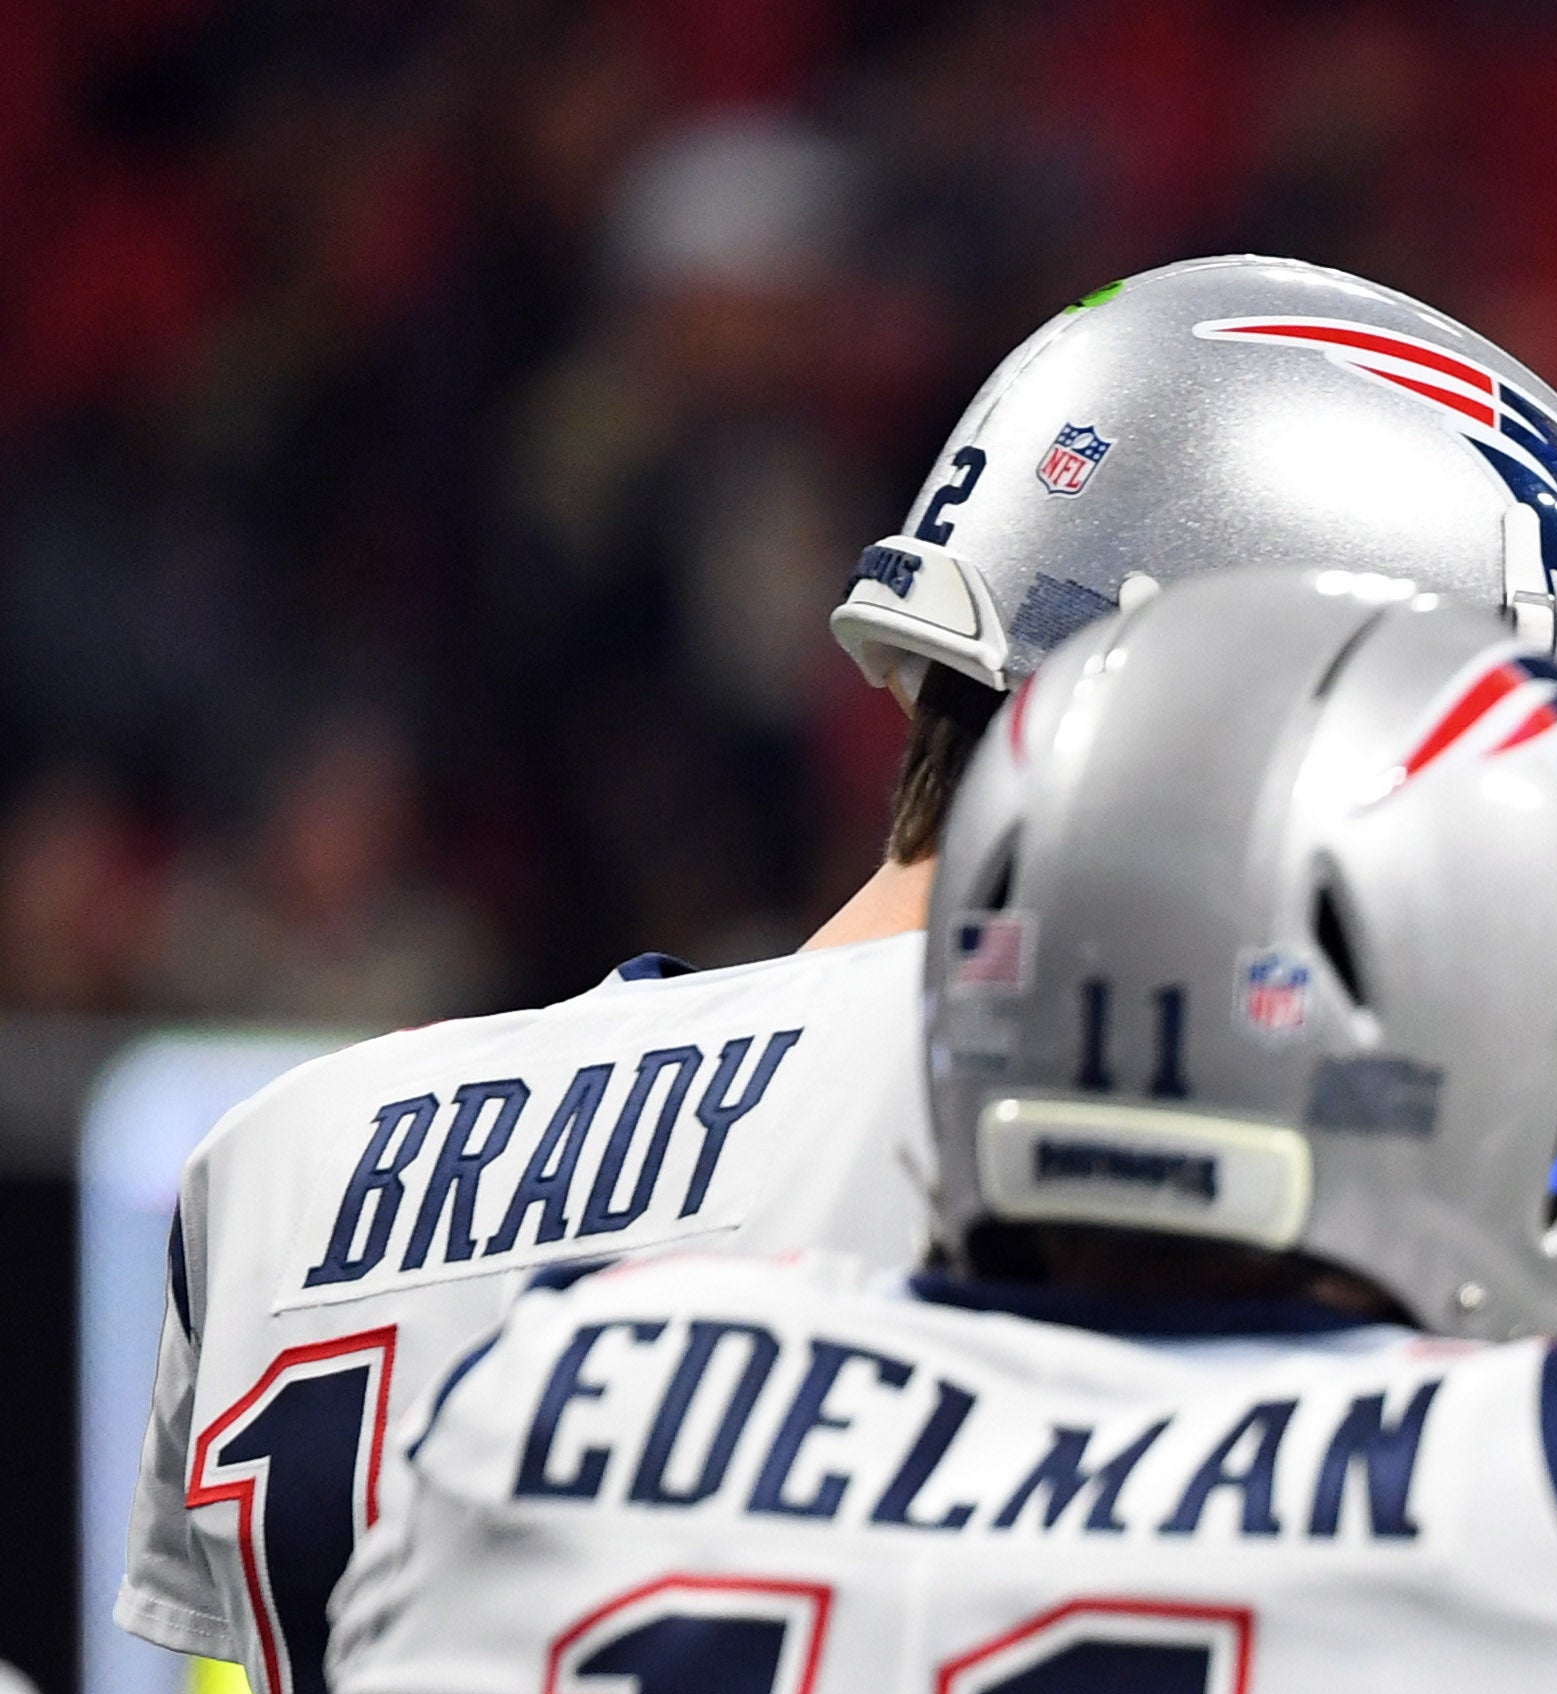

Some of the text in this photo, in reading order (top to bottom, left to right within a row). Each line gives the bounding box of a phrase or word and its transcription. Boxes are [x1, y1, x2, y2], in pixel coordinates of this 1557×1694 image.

[1041, 447, 1087, 490] NFL
[1075, 974, 1190, 1098] 11
[303, 1028, 804, 1289] BRADY
[511, 1318, 1447, 1538] EDELMAN
